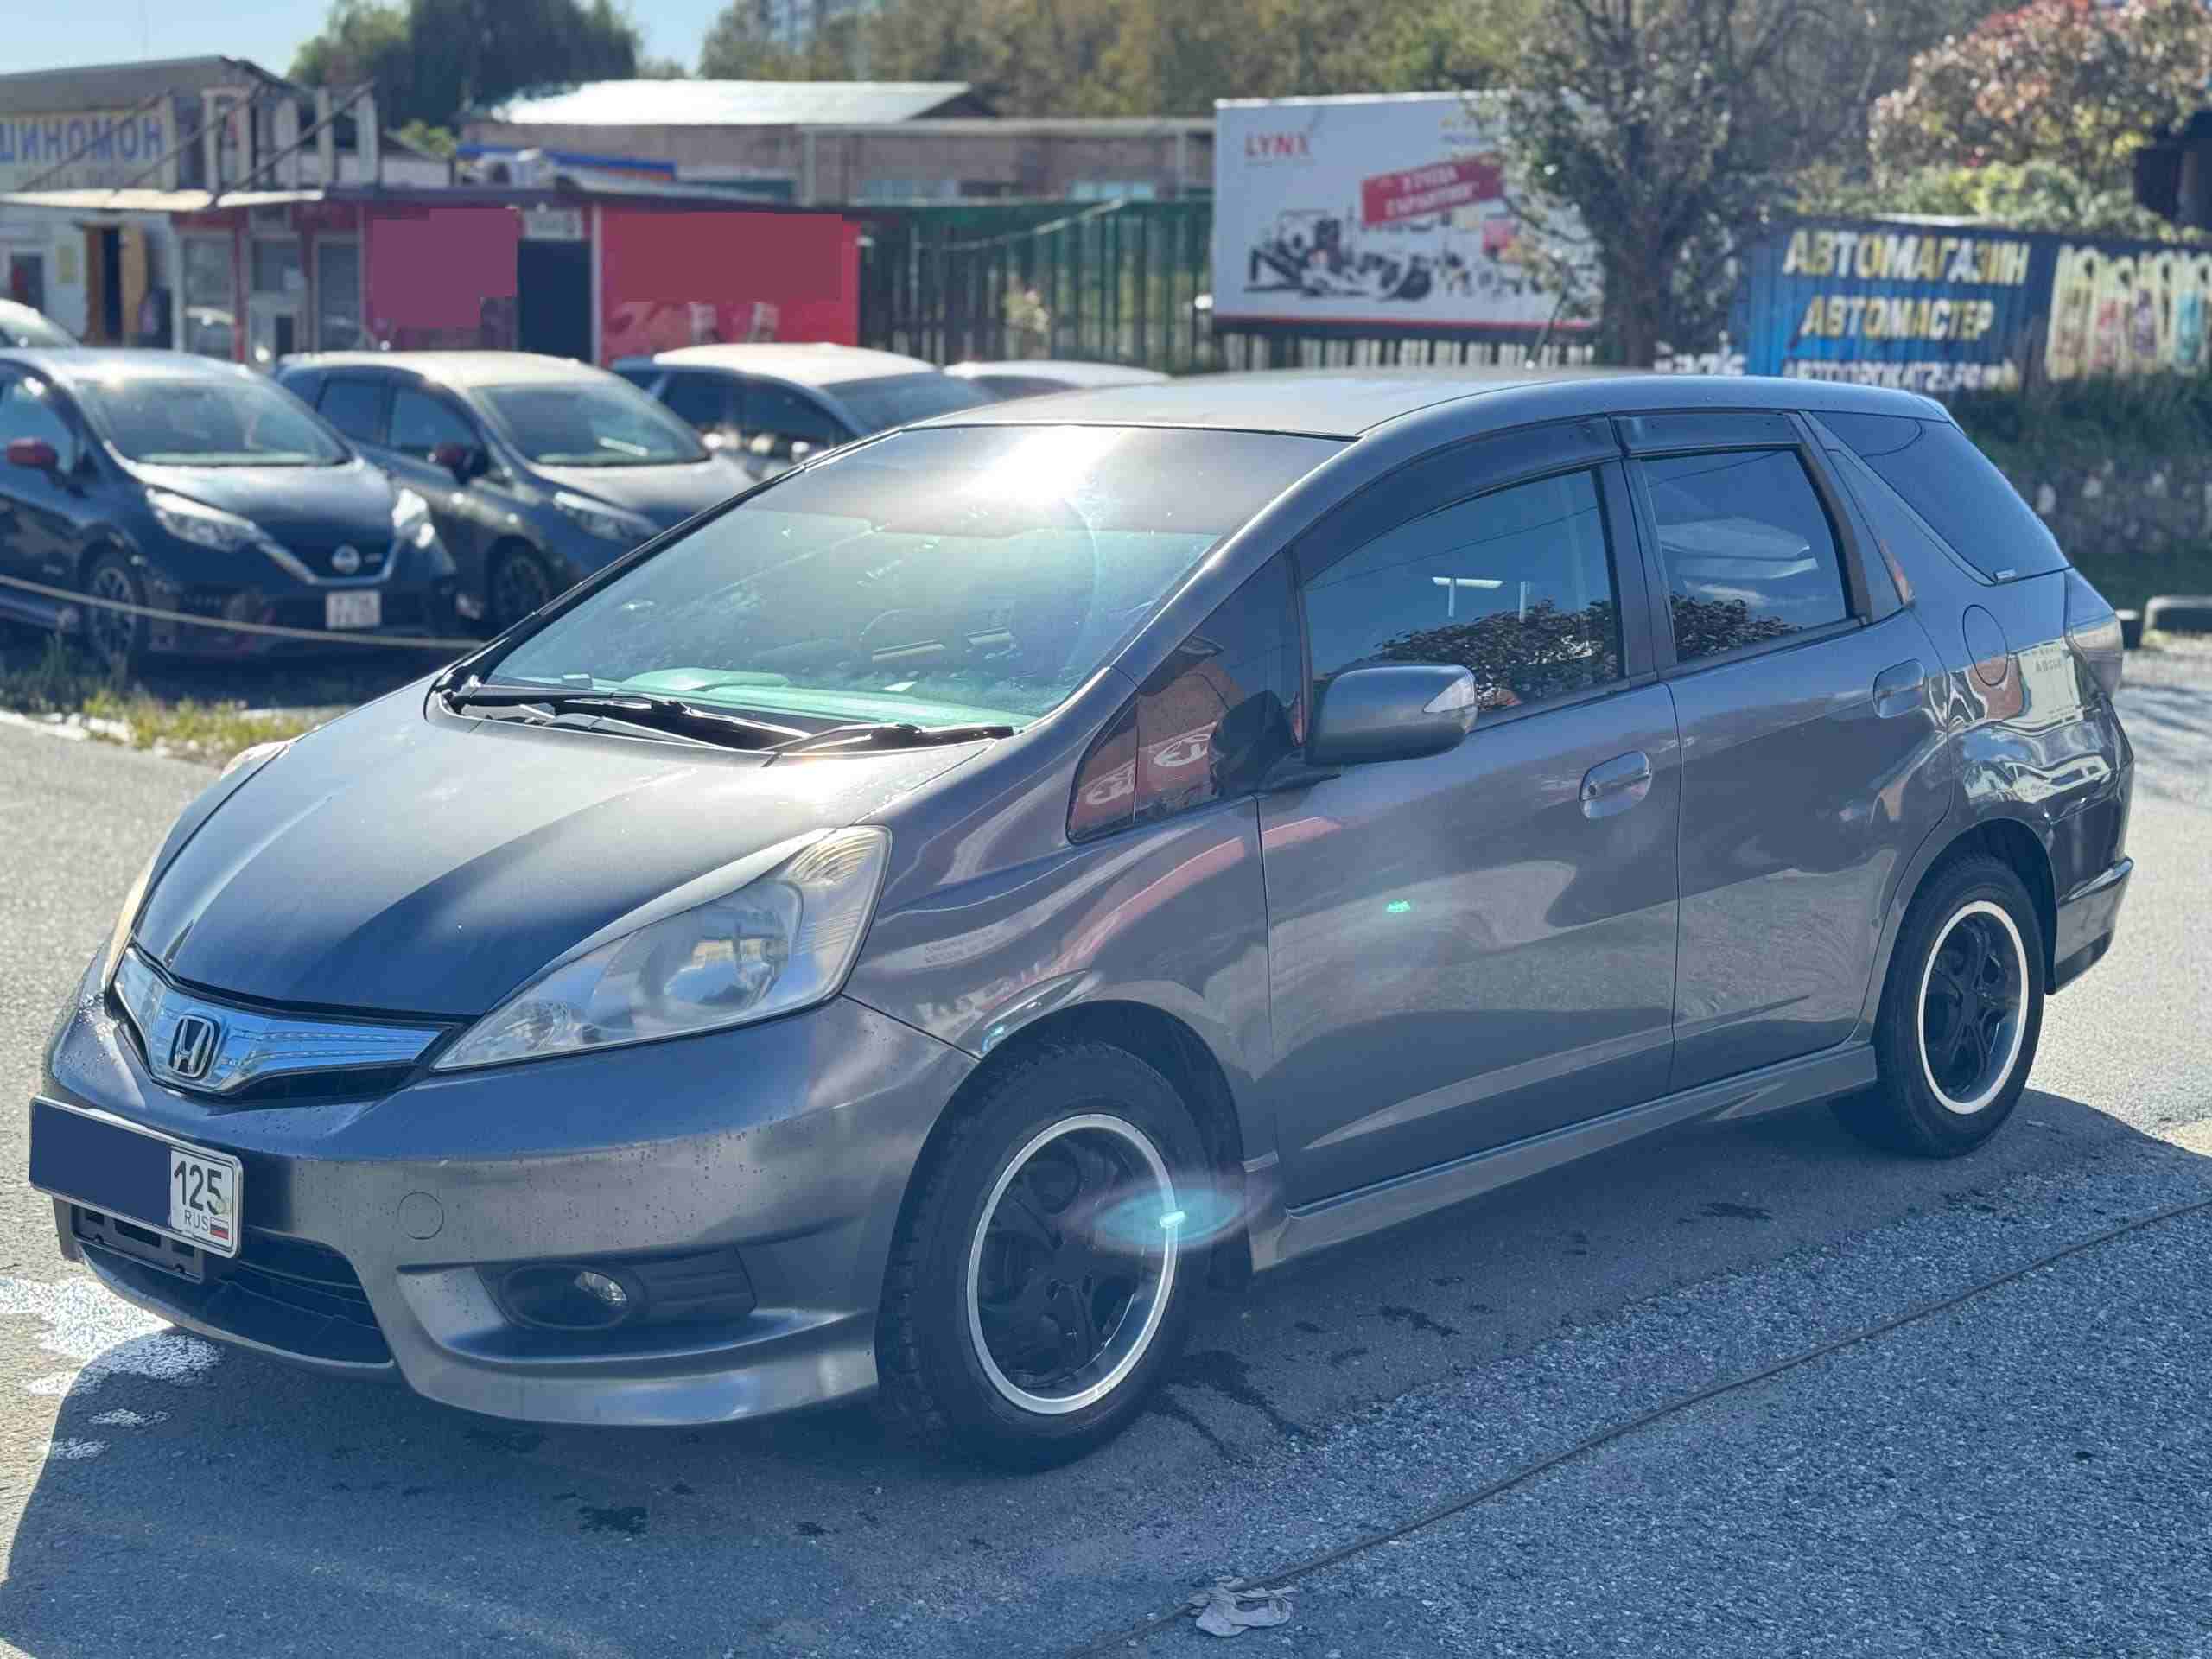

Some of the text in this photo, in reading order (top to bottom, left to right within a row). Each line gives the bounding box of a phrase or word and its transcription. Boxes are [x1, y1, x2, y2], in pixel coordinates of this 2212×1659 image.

[1782, 228, 2031, 286] АВТОМАГАЗИН
[1800, 295, 1996, 340] АВТОМАСТЕР
[173, 1160, 223, 1216] 125
[184, 1209, 210, 1232] RUS
